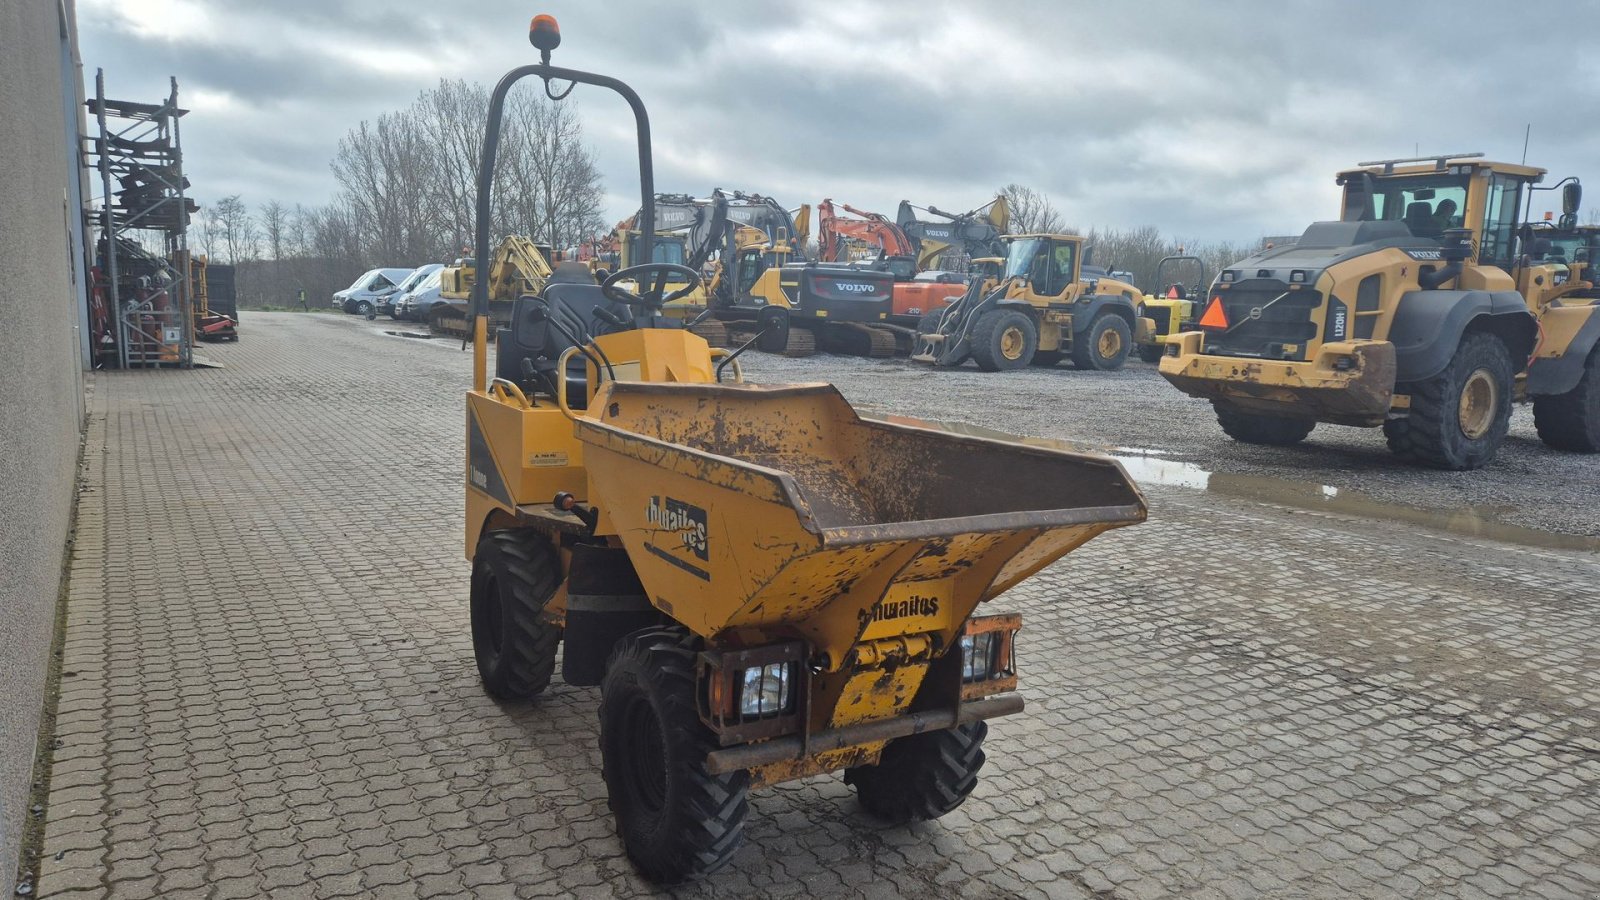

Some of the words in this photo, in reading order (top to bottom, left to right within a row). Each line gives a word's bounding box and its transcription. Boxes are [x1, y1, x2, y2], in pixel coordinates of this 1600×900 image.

[664, 212, 685, 222] VOLVO
[730, 210, 751, 220] VOLVO
[836, 283, 875, 293] VOLVO
